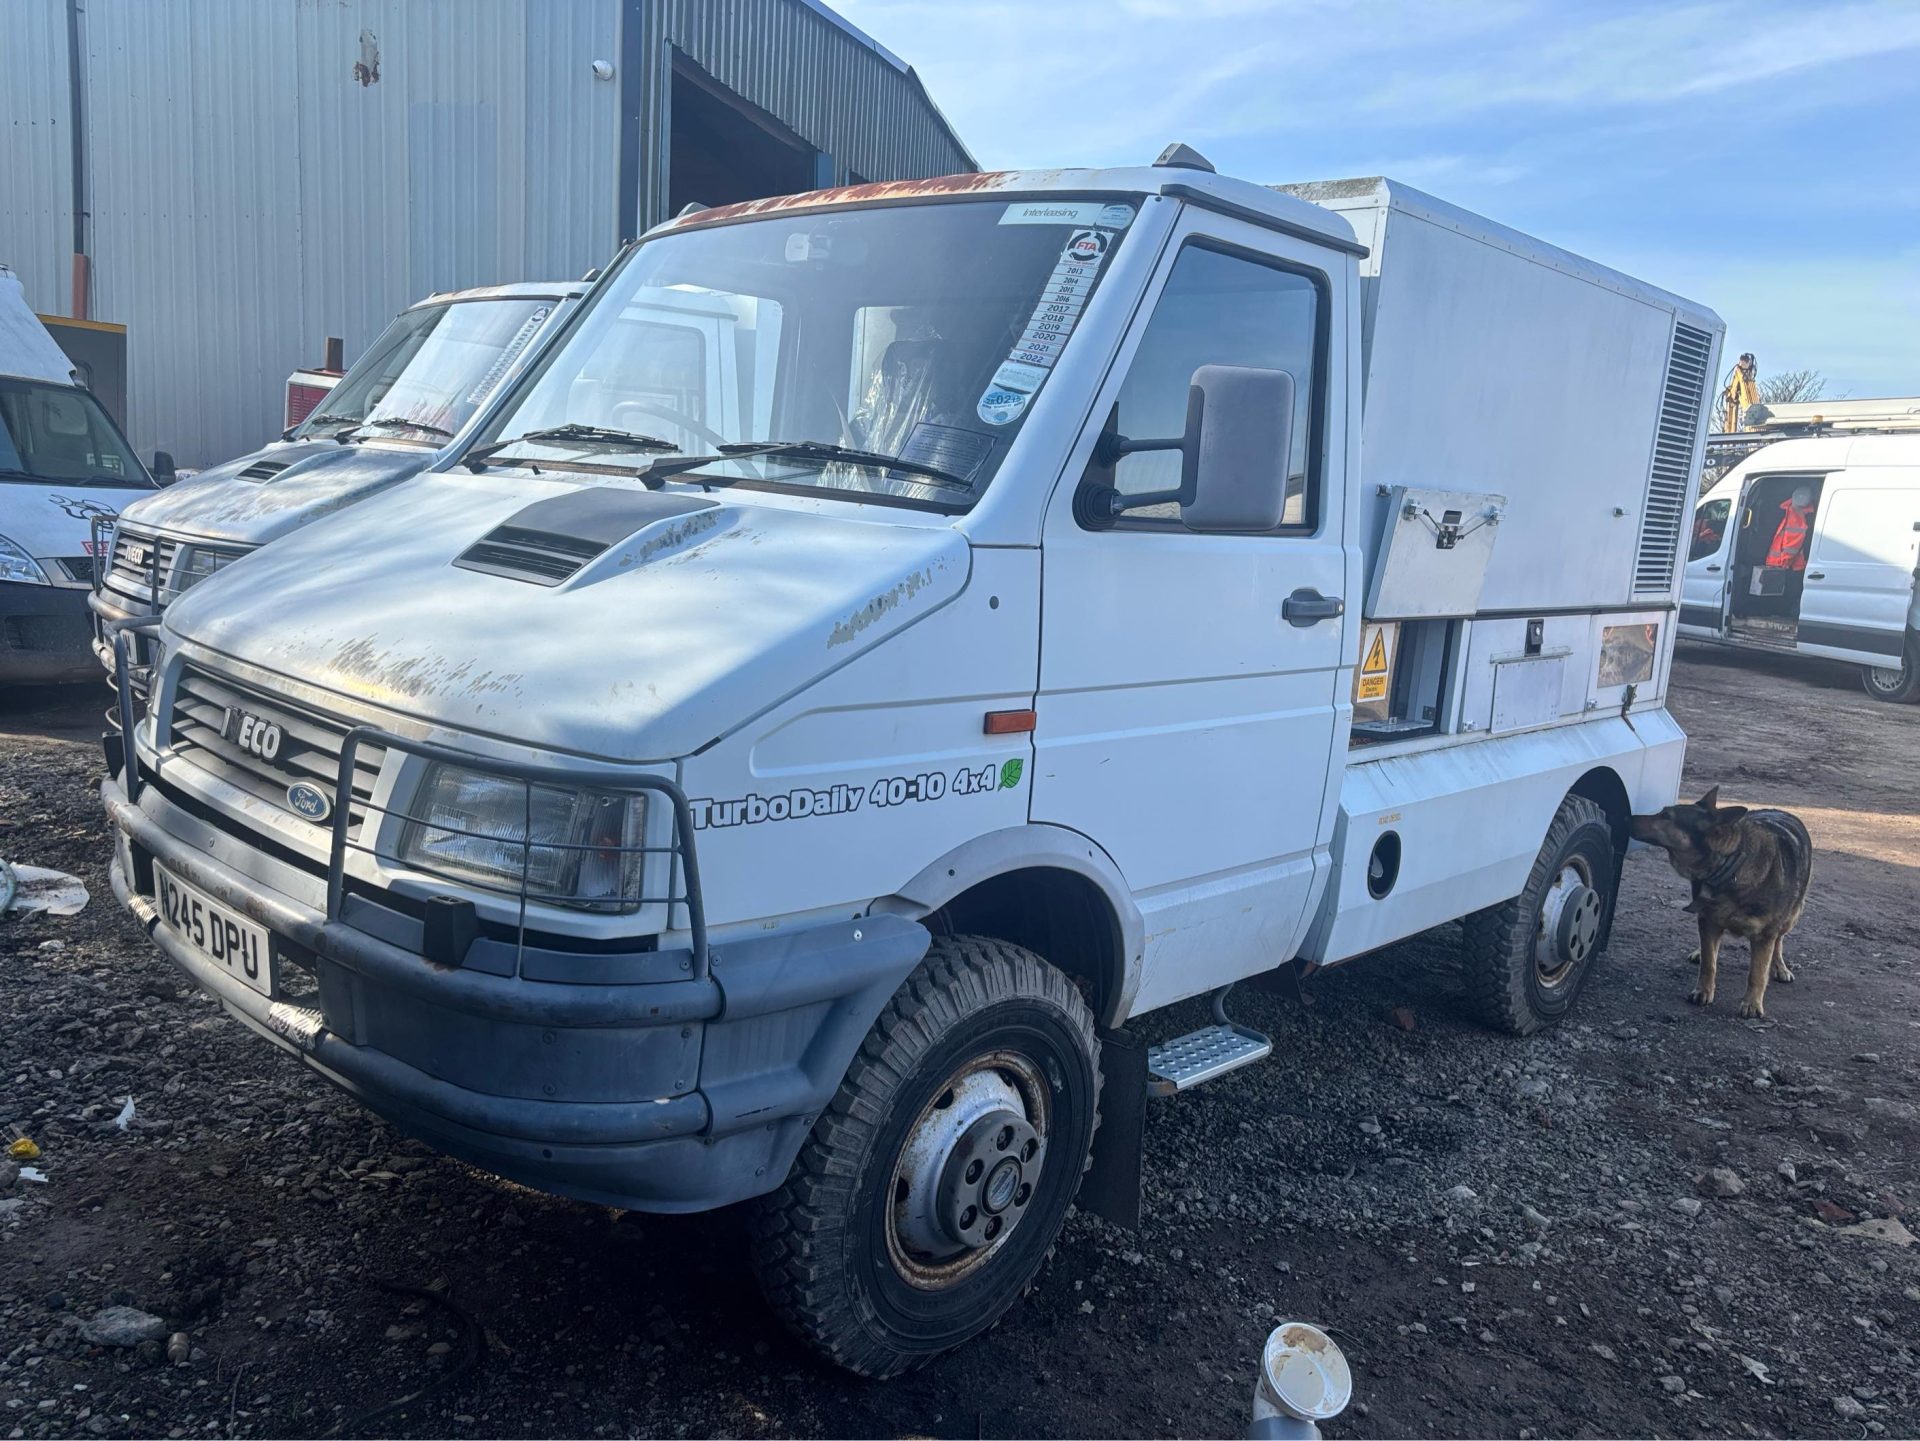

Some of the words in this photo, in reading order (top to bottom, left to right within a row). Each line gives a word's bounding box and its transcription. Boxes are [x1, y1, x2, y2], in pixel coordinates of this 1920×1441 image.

[1076, 241, 1098, 251] FTA
[1067, 267, 1084, 275] 2013
[1063, 276, 1079, 285] 2014
[1059, 285, 1075, 294] 2015
[1055, 295, 1070, 303] 2016
[1046, 304, 1070, 313] 2017
[1041, 313, 1065, 322] 2018
[1038, 322, 1060, 331] 2019
[1032, 331, 1056, 341] 2020
[1027, 342, 1050, 353] 2021
[1019, 352, 1045, 364] 2022
[1362, 676, 1384, 687] DANGER
[690, 784, 865, 830] TurboDaily
[869, 772, 946, 807] 40-10
[952, 764, 996, 796] 4x4
[158, 871, 205, 947] N245
[209, 910, 259, 980] DPU
